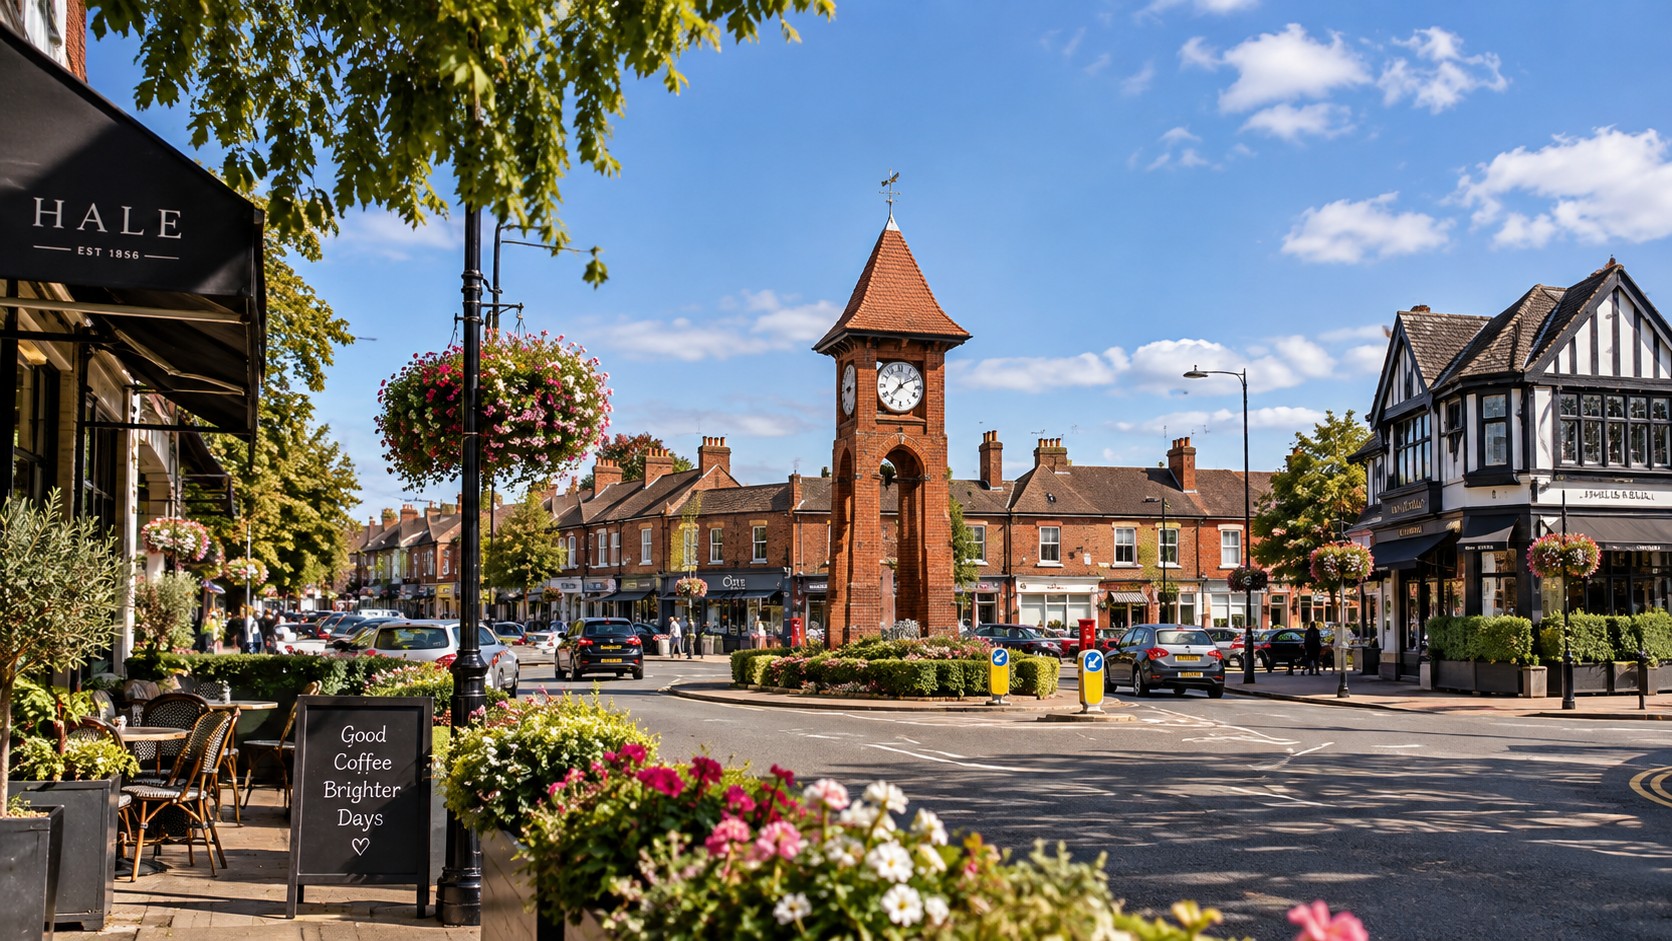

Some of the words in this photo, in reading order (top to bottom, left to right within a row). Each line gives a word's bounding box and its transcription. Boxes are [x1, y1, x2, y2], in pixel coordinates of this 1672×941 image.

[32, 196, 182, 239] HALE
[77, 245, 102, 257] EST
[340, 724, 387, 748] Good
[334, 752, 392, 775] Coffee
[323, 780, 401, 804] Brighter
[337, 808, 384, 832] Days
